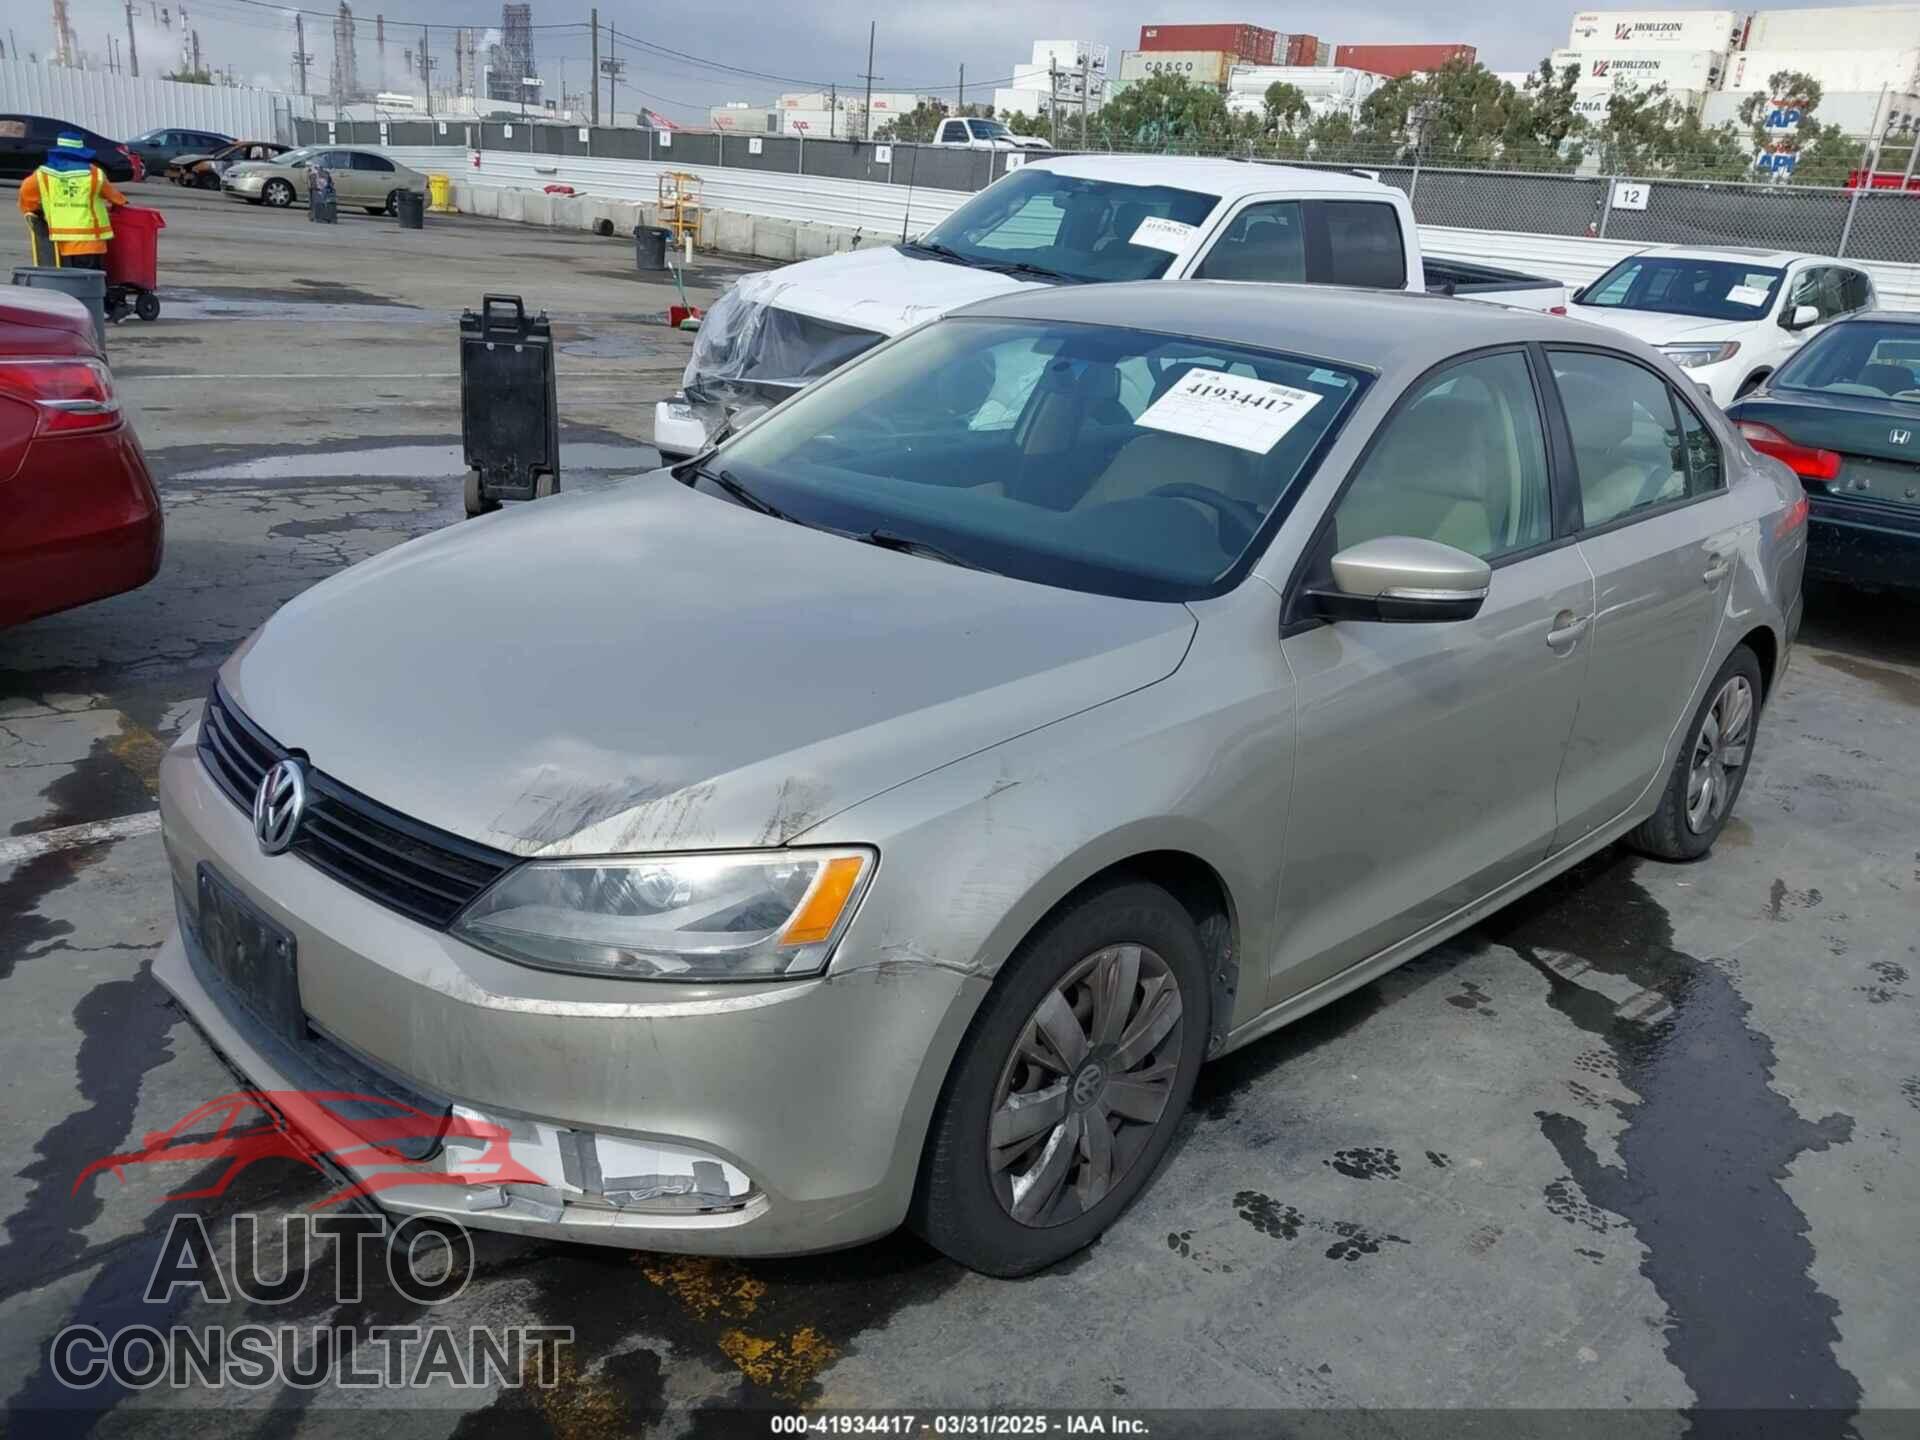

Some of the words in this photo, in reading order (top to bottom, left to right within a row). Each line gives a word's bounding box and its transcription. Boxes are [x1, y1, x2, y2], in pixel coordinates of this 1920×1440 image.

[1634, 22, 1683, 32] HORIZON
[1145, 61, 1194, 72] COSCO
[1611, 60, 1661, 70] HORIZON
[1573, 101, 1601, 112] CMA
[1624, 190, 1640, 203] 12
[1186, 383, 1294, 413] 41934417
